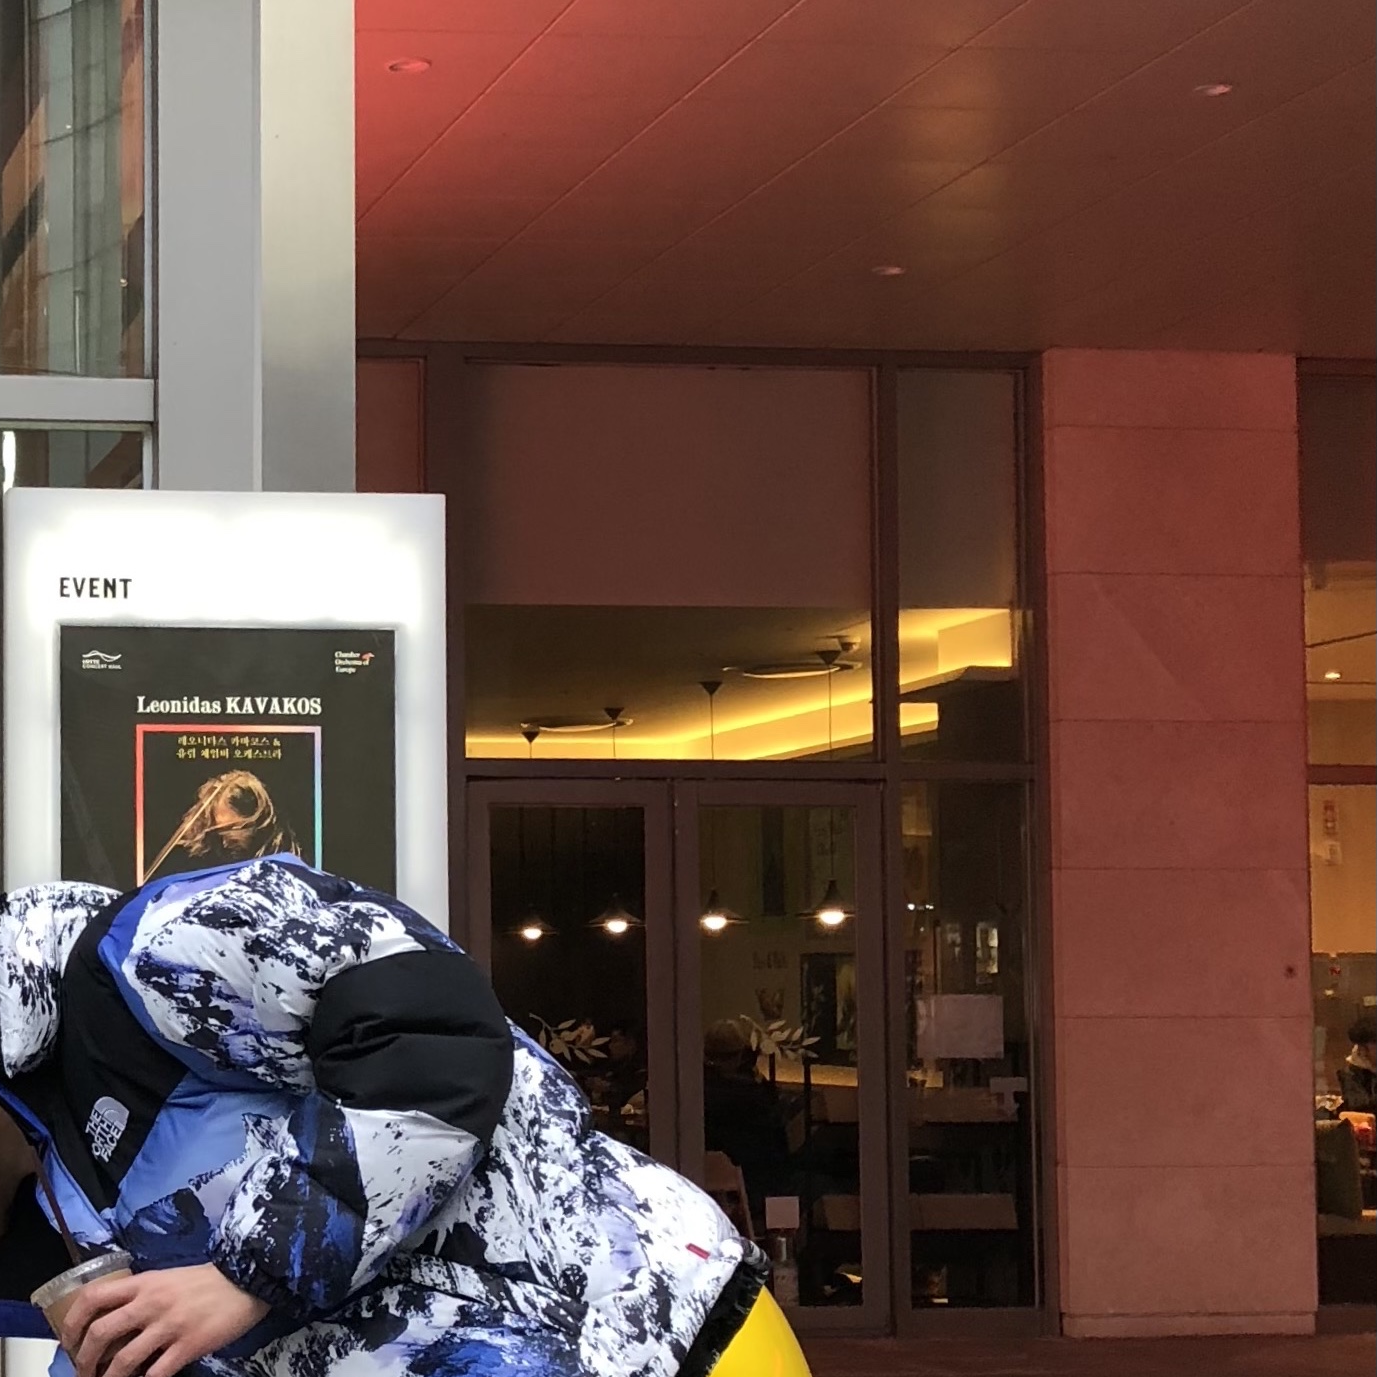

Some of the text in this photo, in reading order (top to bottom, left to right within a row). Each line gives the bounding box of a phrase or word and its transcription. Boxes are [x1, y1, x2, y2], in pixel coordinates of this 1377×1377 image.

[59, 577, 132, 599] EVENT
[136, 695, 322, 715] Leonidas KAVAKOS
[177, 736, 228, 747] 레오니다스
[230, 736, 270, 747] 카바코스
[176, 748, 196, 759] 유럽
[233, 749, 282, 760] 오케스트라
[85, 1109, 102, 1136] THE
[100, 1124, 124, 1163] FACE
